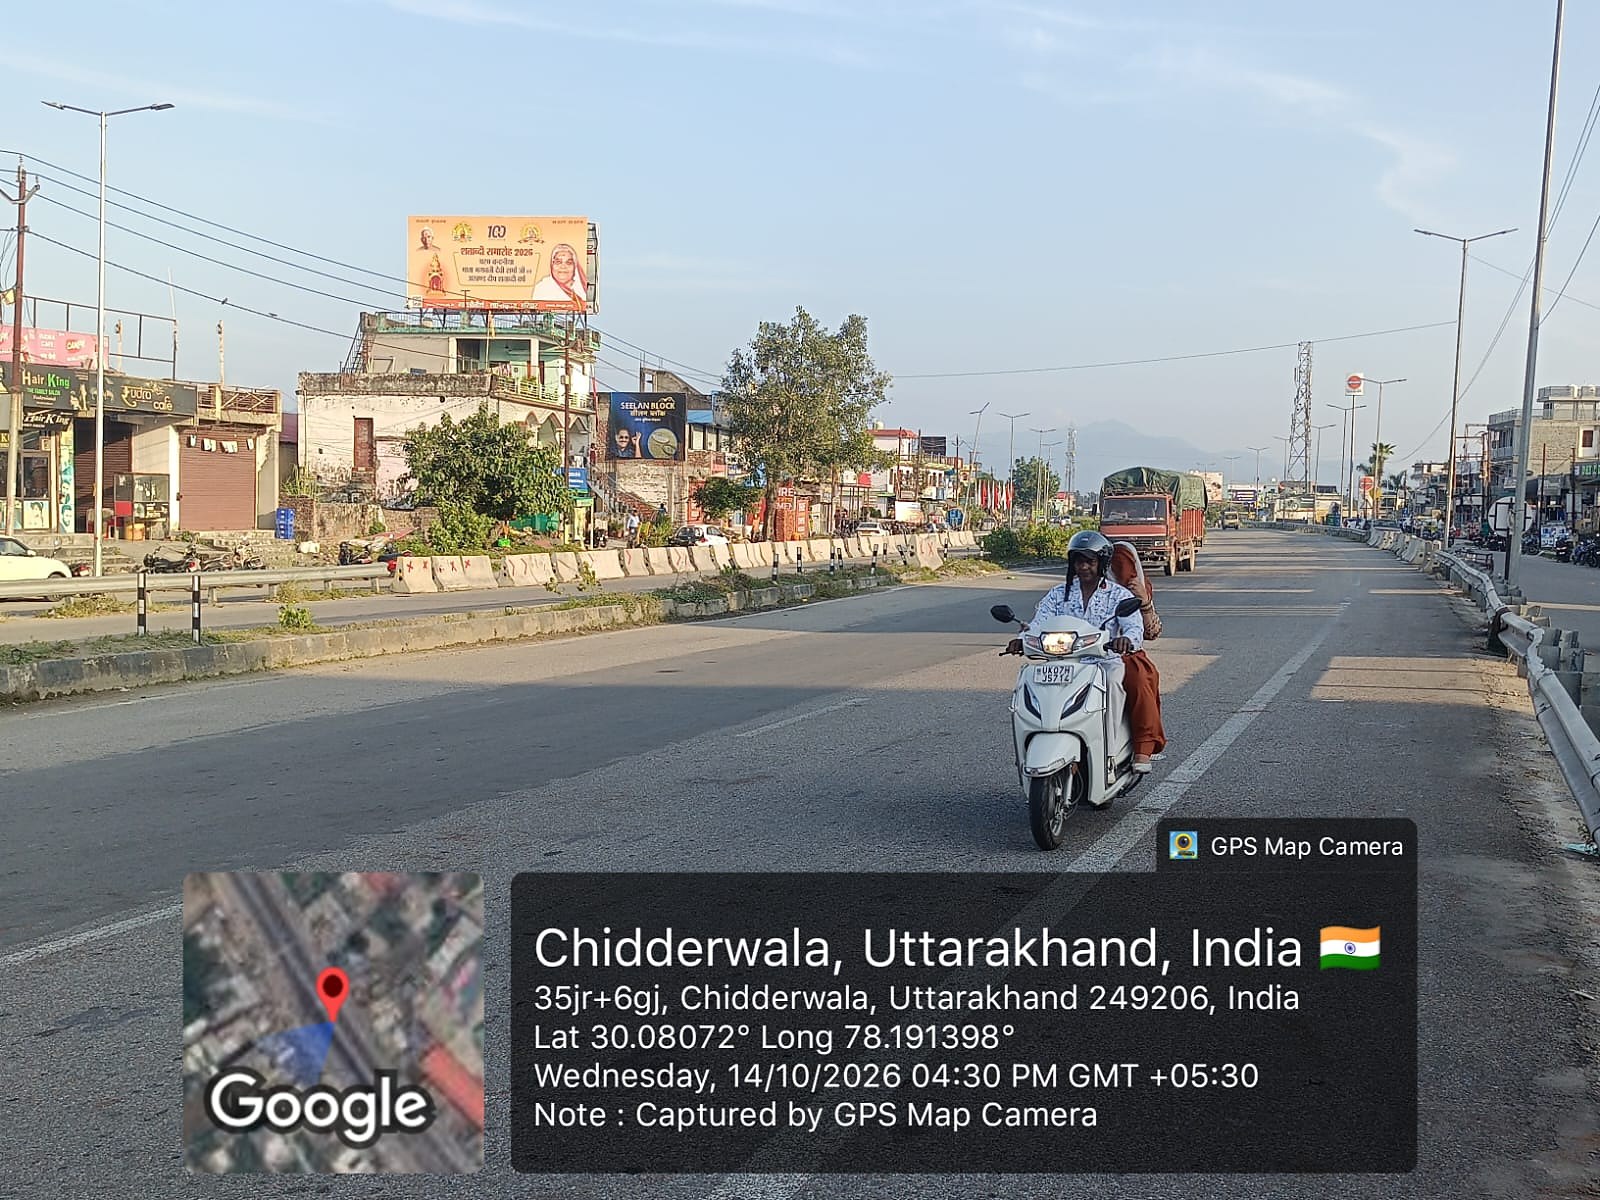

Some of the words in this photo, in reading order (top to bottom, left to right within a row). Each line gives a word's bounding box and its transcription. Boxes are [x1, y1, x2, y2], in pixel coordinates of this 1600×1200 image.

[22, 371, 45, 386] Hair
[47, 373, 70, 389] King
[620, 402, 650, 410] SEELAN
[651, 401, 676, 410] BLOCK
